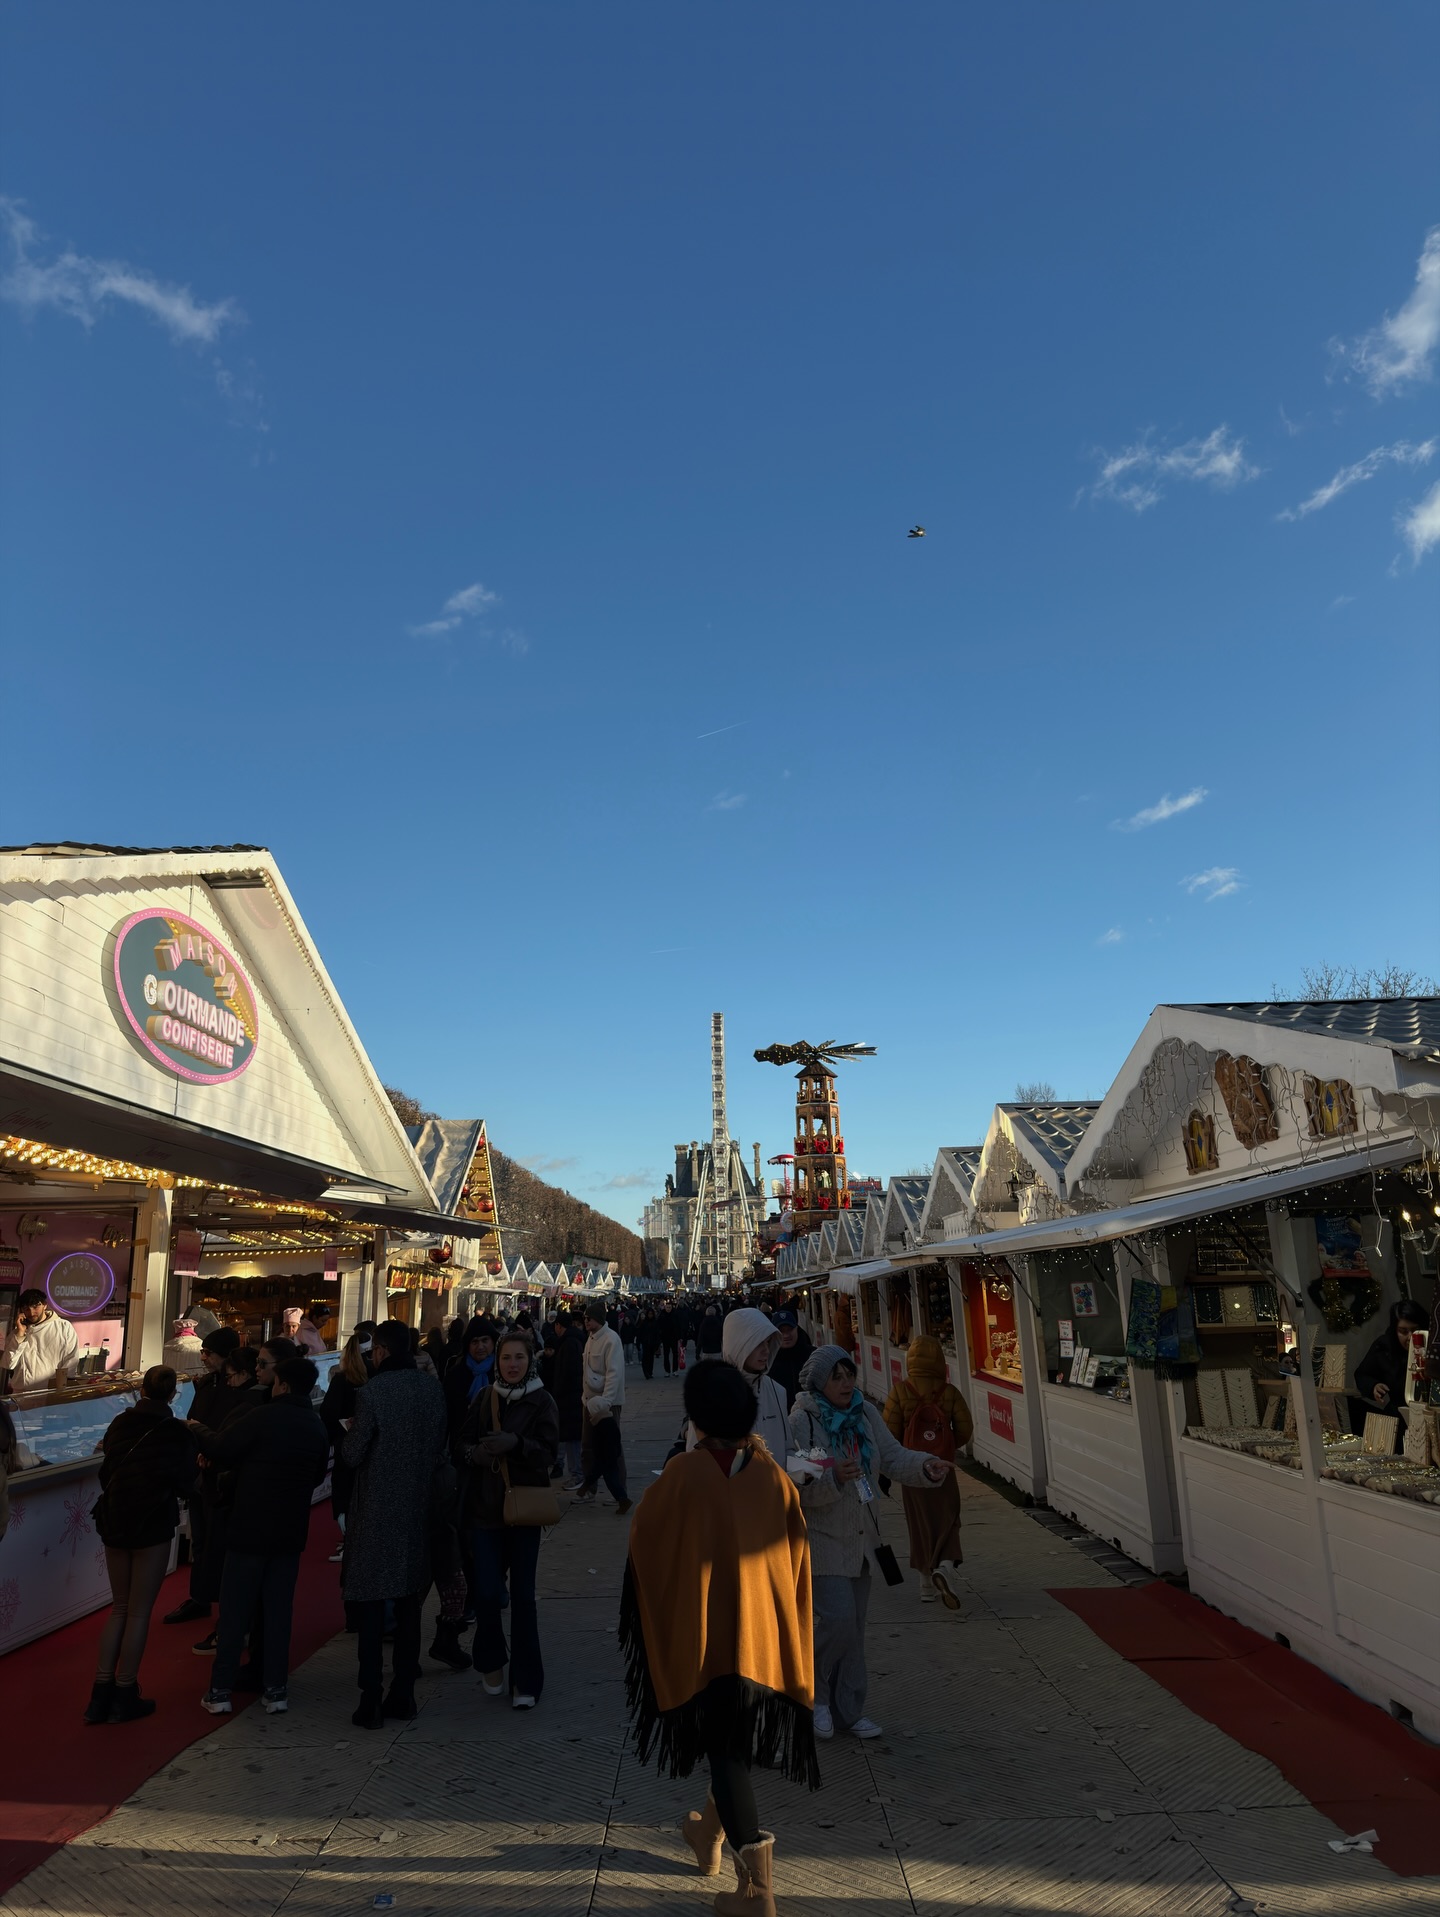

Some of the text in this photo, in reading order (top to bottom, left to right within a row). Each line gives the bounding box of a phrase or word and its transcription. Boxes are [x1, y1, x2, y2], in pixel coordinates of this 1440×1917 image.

[167, 933, 238, 998] MAISON
[143, 973, 245, 1047] GOURMANDE
[161, 1017, 235, 1068] CONFISERIE
[54, 1285, 99, 1297] GOURMANDE
[62, 1259, 95, 1276] MAISON
